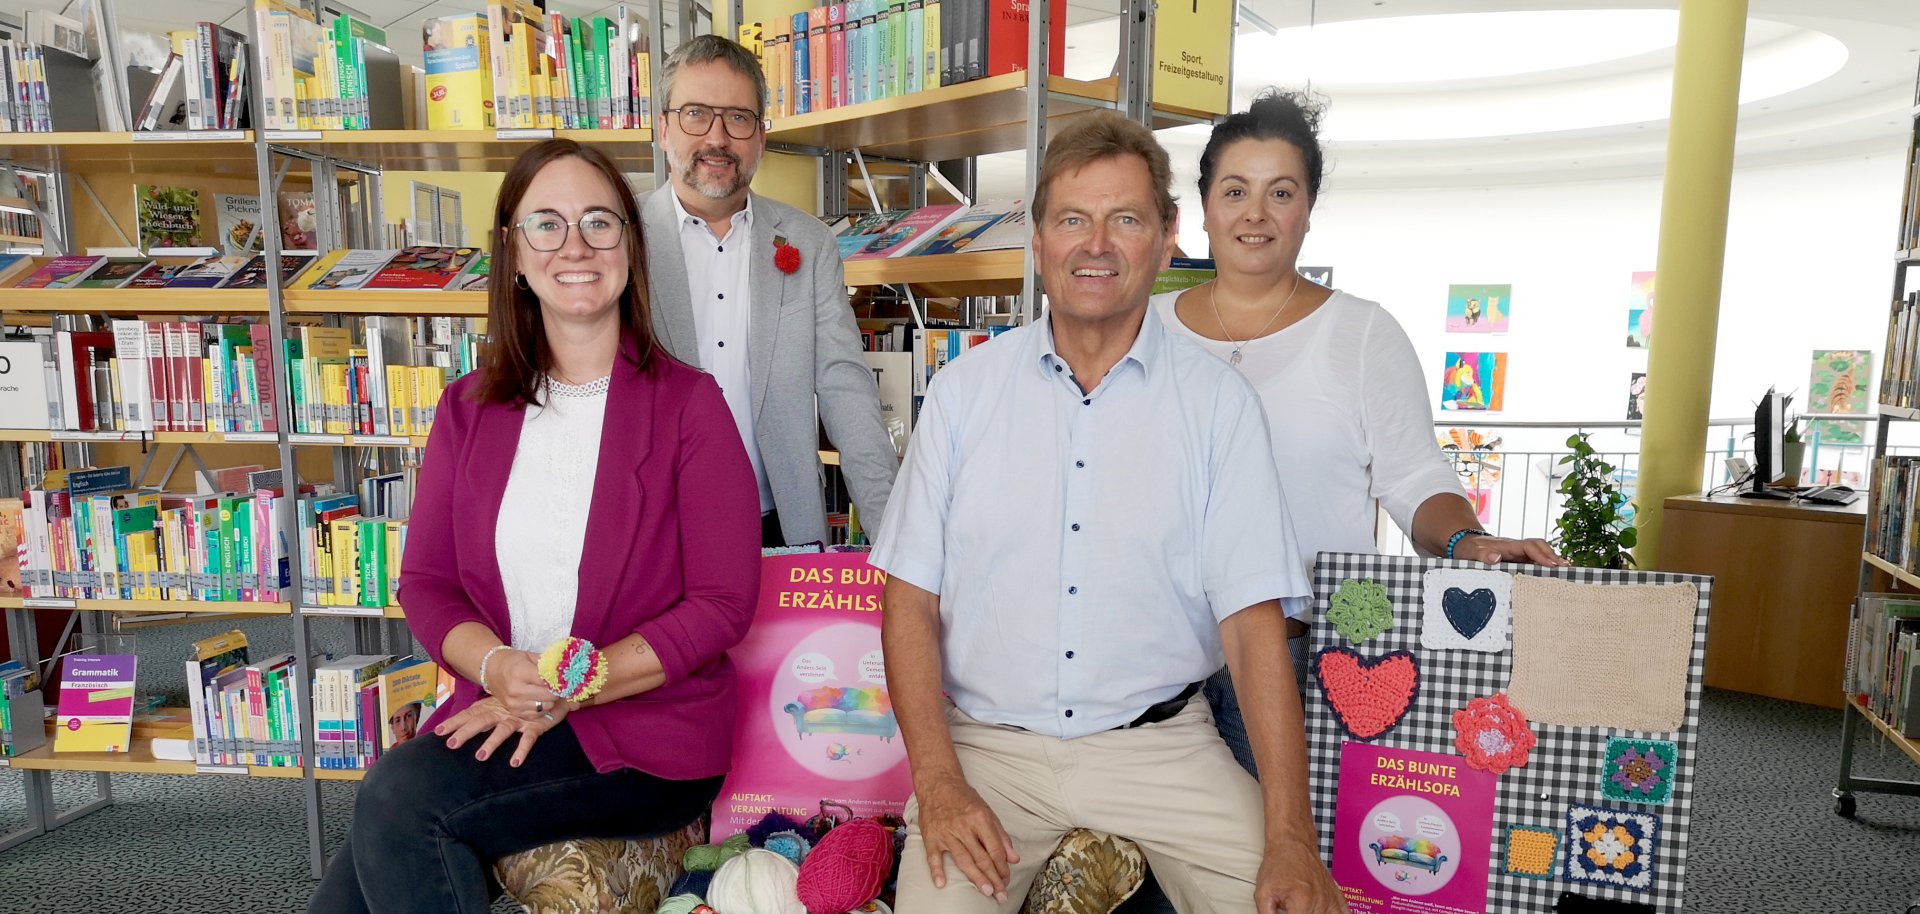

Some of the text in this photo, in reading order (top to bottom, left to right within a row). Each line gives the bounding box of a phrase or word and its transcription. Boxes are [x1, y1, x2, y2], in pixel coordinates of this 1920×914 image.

[1181, 51, 1203, 66] Sport,
[338, 57, 346, 94] ITALIENISCH
[576, 62, 584, 92] SPANISCH
[1159, 60, 1224, 85] Freizeitgestaltung
[143, 202, 168, 210] Wald-
[225, 197, 258, 205] Grillen
[150, 211, 188, 219] Wiesen-
[145, 220, 193, 230] Kochbuch
[872, 368, 884, 388] T
[790, 567, 834, 583] DAS
[779, 590, 883, 612] ERZÄHLS
[72, 668, 118, 676] Grammatik
[272, 698, 280, 728] FRANZÖSISCH
[1377, 757, 1456, 778] DAS BUNTE
[1371, 774, 1460, 797] ERZÄHLSOFA
[731, 793, 774, 802] AUFTAKT-
[731, 805, 807, 816] VERANSTALTUNG
